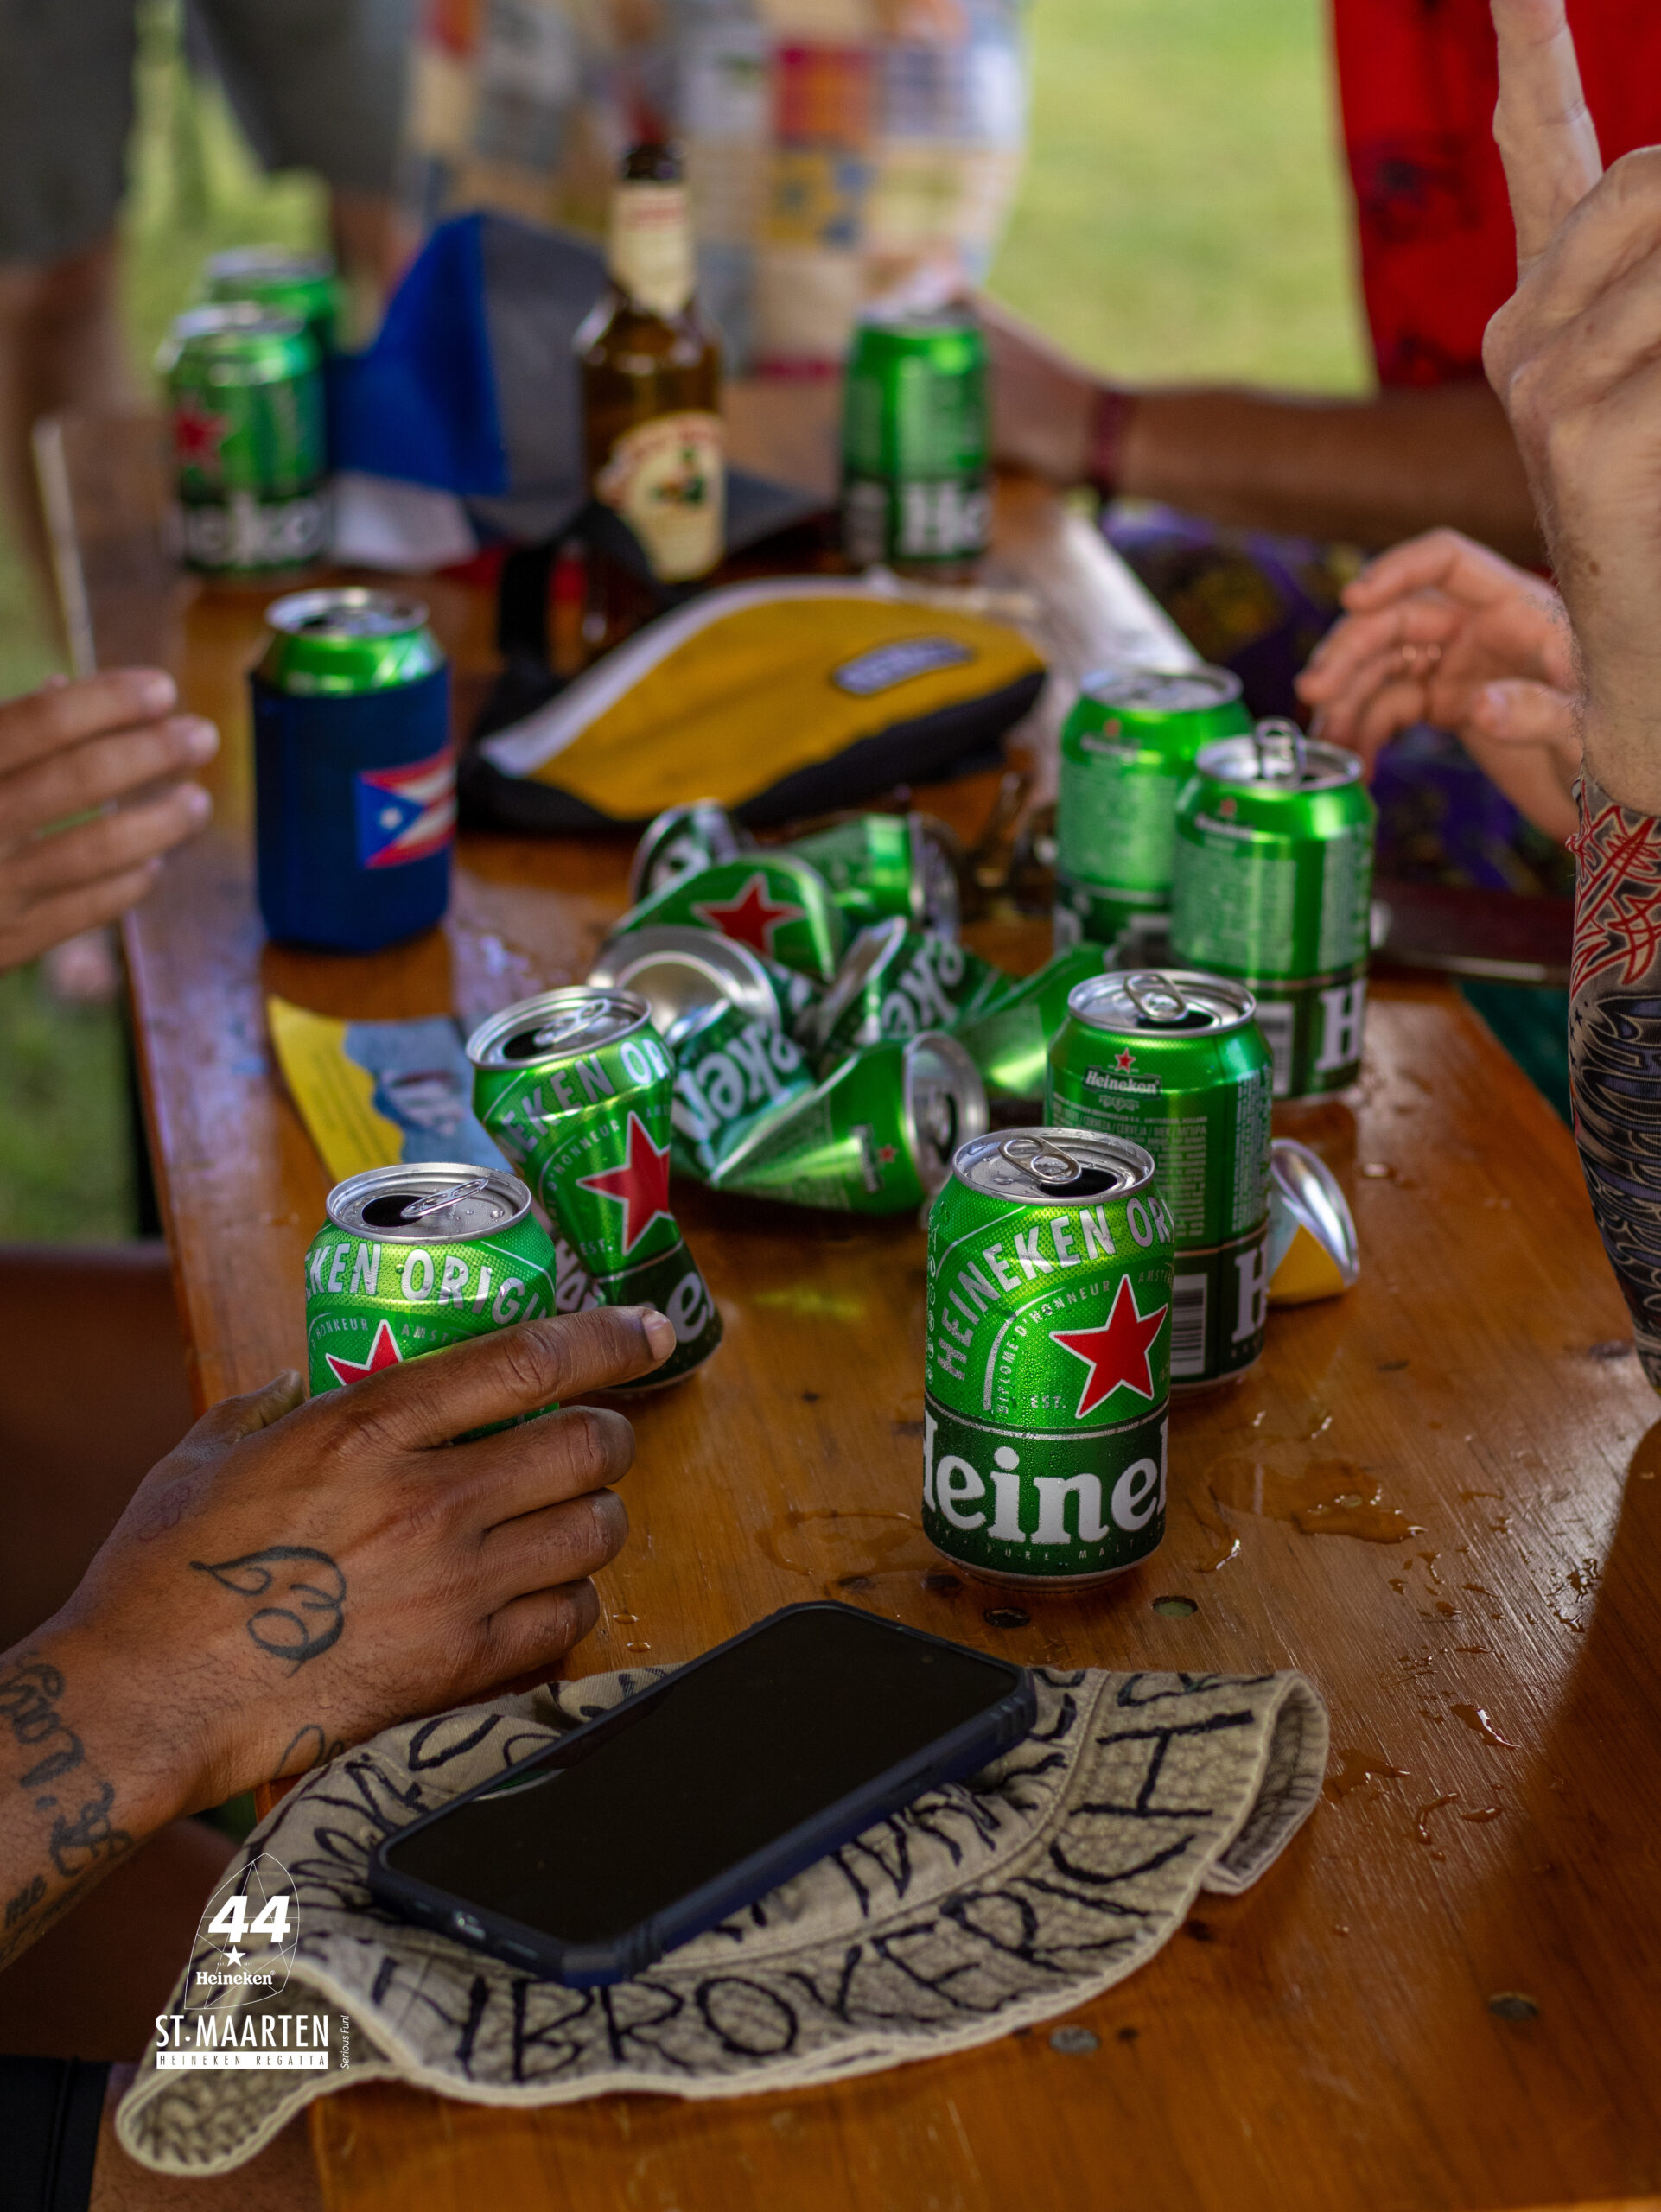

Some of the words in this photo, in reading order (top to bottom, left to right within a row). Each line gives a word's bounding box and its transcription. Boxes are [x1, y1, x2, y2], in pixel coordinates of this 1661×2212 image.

[305, 1243, 382, 1299] KEN
[937, 1204, 1117, 1381] HEINEKEN
[1014, 1281, 1111, 1337] D'HONNEUR
[1030, 1394, 1066, 1409] EST.
